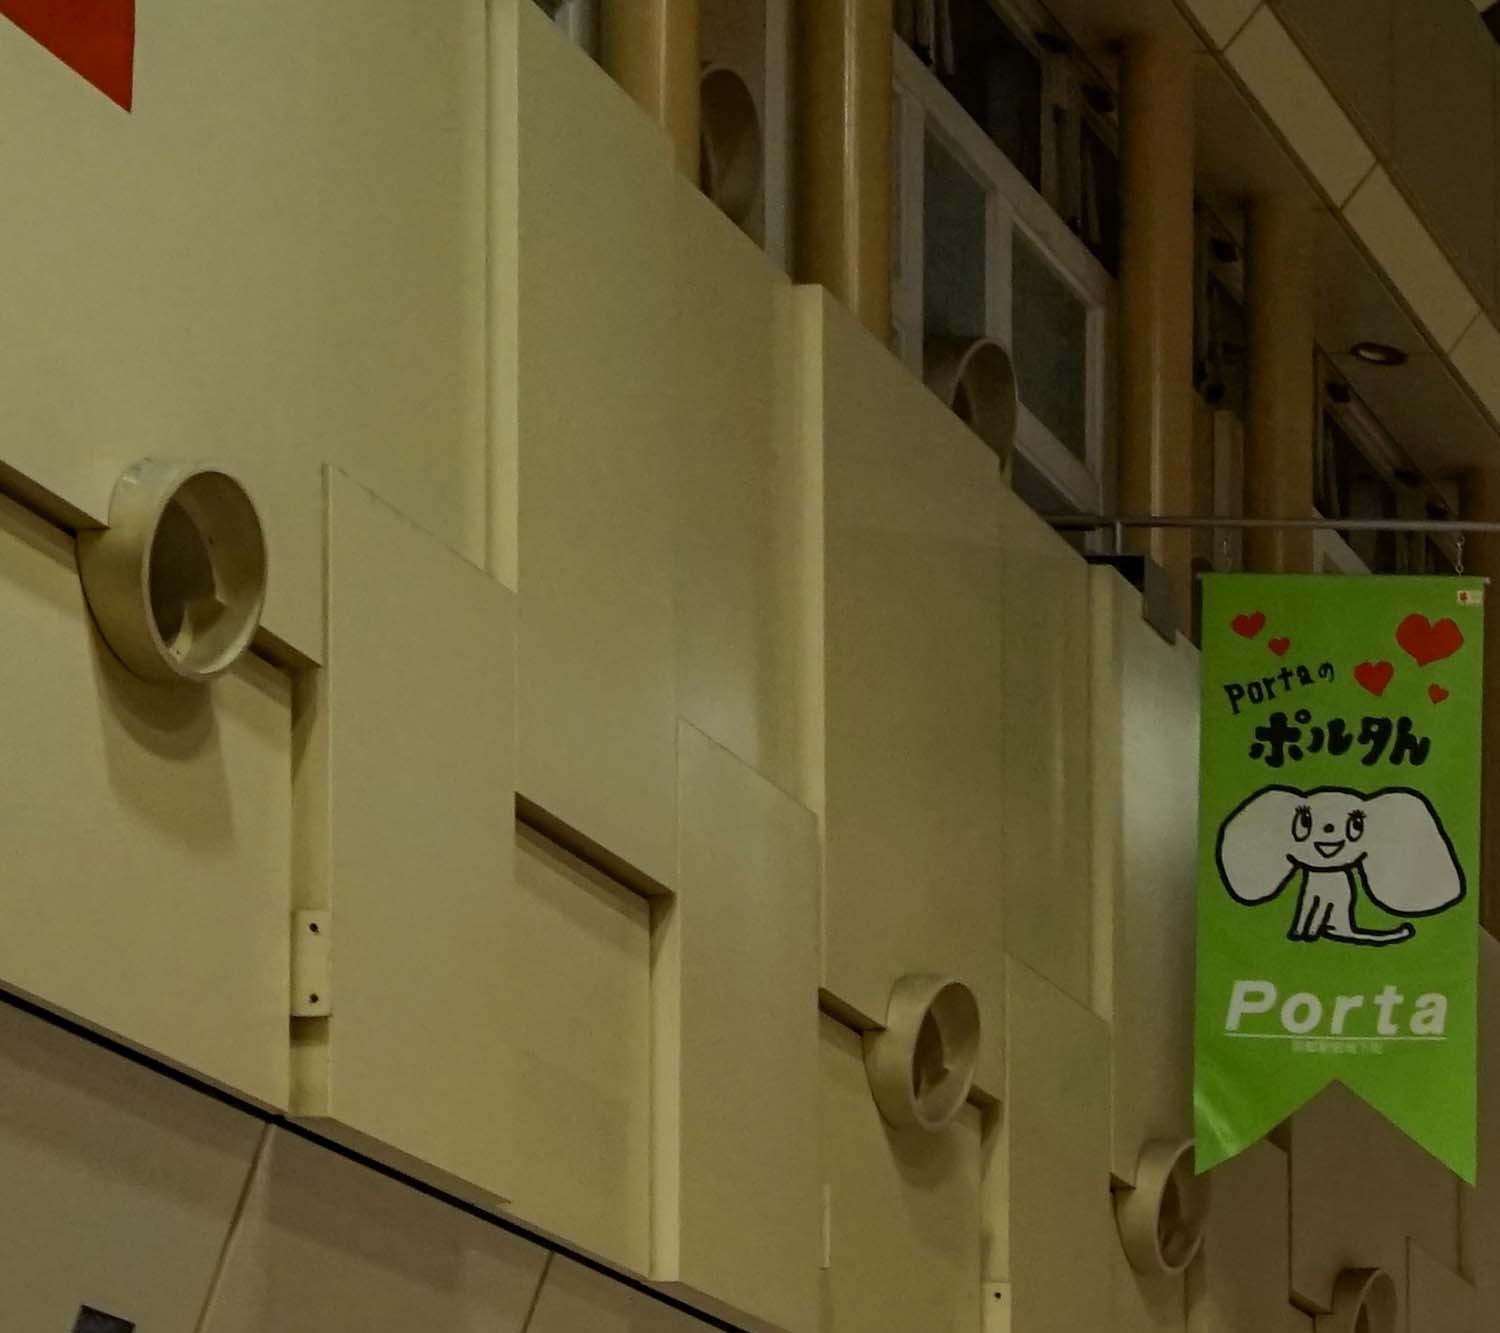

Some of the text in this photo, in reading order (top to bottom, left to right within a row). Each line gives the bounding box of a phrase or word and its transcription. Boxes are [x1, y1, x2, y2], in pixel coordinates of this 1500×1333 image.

[1248, 708, 1431, 768] ポルタん
[1225, 979, 1448, 1036] Porta
